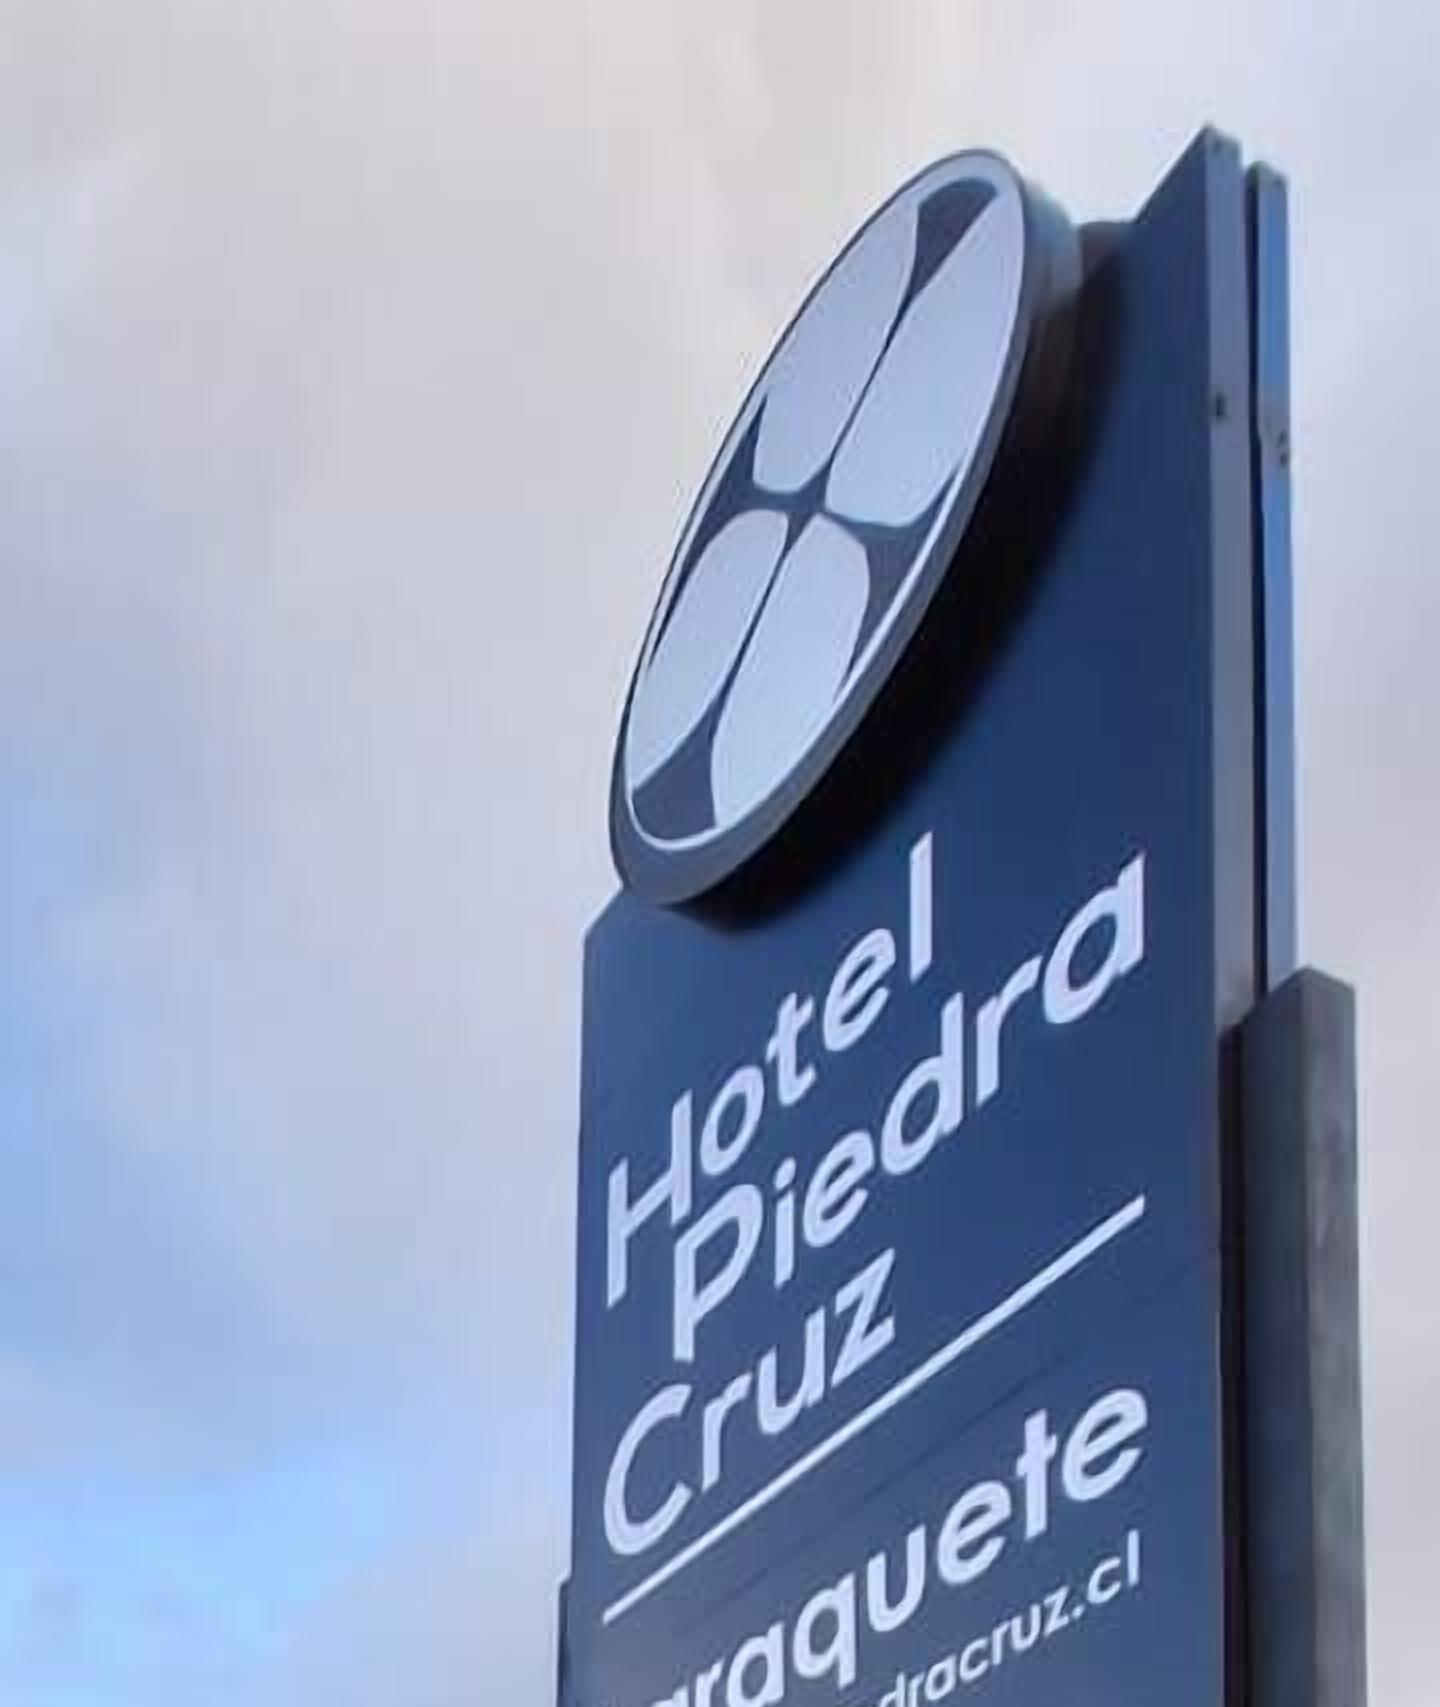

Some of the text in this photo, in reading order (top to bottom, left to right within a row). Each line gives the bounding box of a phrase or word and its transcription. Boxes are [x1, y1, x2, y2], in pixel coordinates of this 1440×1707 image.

[606, 830, 934, 1309] Hotel
[672, 852, 1146, 1362] Piedra
[603, 1248, 896, 1556] Cruz
